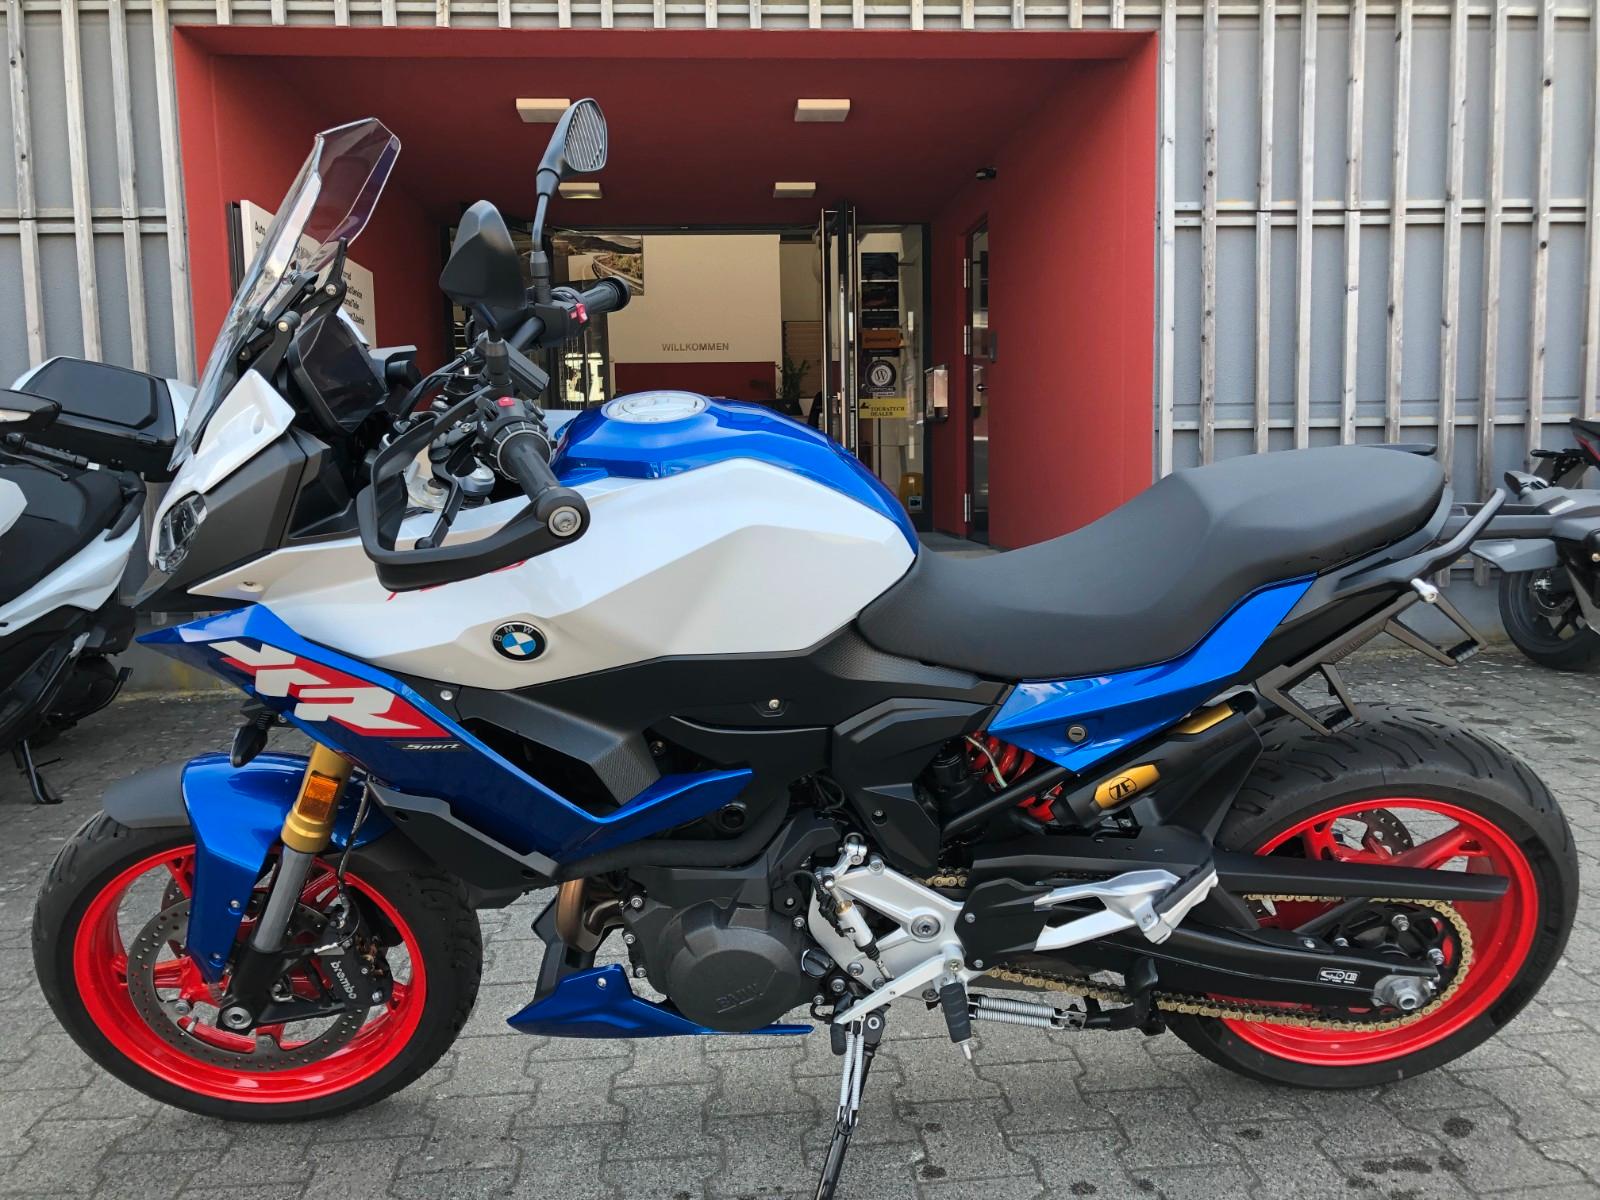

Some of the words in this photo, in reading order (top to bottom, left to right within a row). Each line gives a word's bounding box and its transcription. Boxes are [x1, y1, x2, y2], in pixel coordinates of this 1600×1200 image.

[661, 342, 729, 352] WILLKOMMEN
[493, 625, 534, 642] BMW
[402, 743, 461, 751] Sport
[1109, 778, 1136, 800] ZF
[330, 960, 357, 999] brembo
